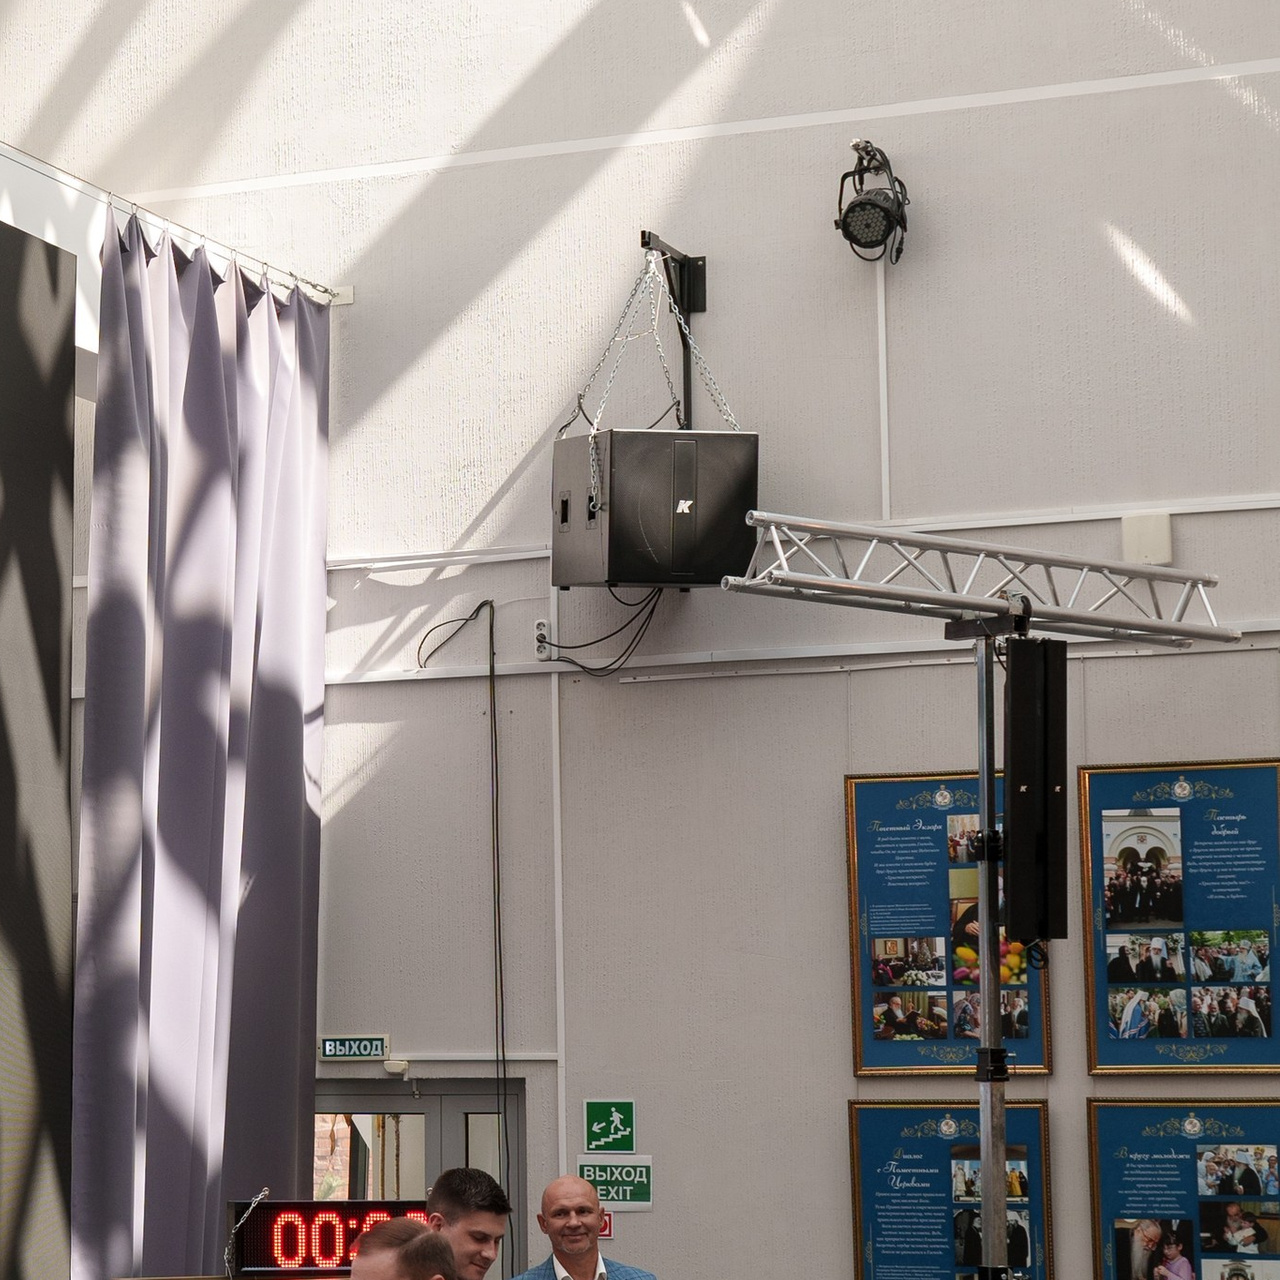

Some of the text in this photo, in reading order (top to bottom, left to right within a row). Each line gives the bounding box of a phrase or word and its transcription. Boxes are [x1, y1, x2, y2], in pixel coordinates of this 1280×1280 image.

[325, 1040, 382, 1056] ВЫХОД
[584, 1166, 647, 1184] ВЫХОД
[597, 1186, 633, 1200] EXIT
